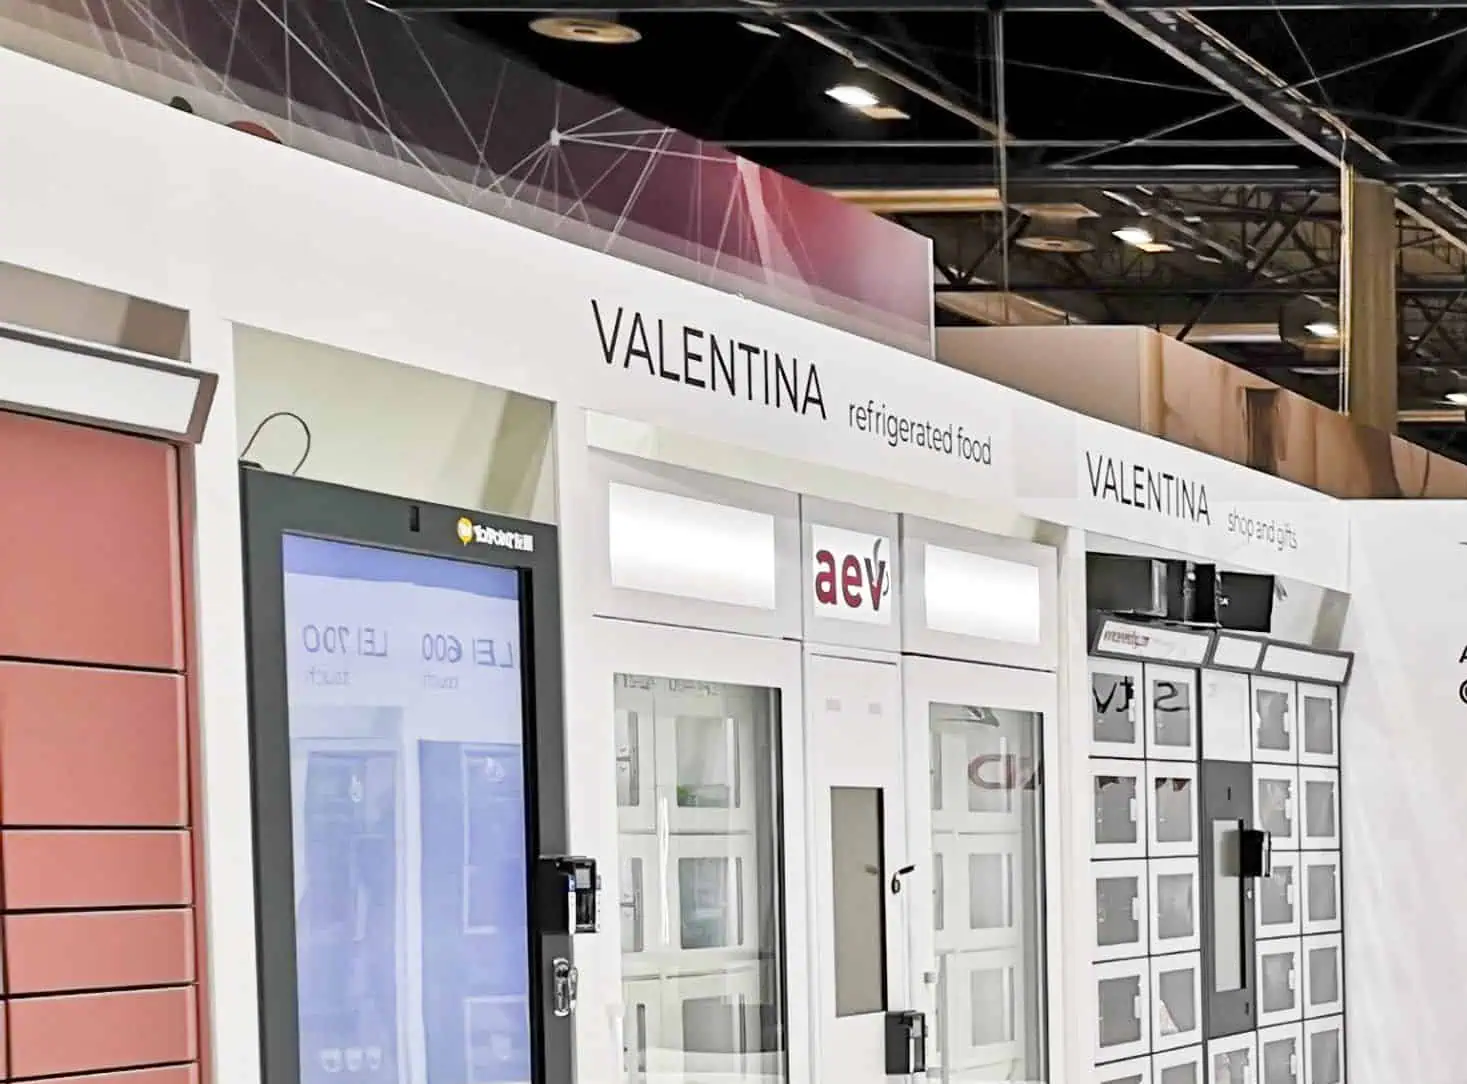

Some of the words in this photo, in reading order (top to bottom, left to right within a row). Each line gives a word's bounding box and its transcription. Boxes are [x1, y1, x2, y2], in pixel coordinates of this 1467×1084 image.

[591, 299, 827, 420] VALENTINA
[848, 399, 953, 455] refrigerated
[957, 426, 992, 465] food
[1085, 450, 1212, 527] VALENTINA
[1227, 505, 1254, 544] shop
[1256, 516, 1276, 543] and
[815, 548, 890, 612] aev
